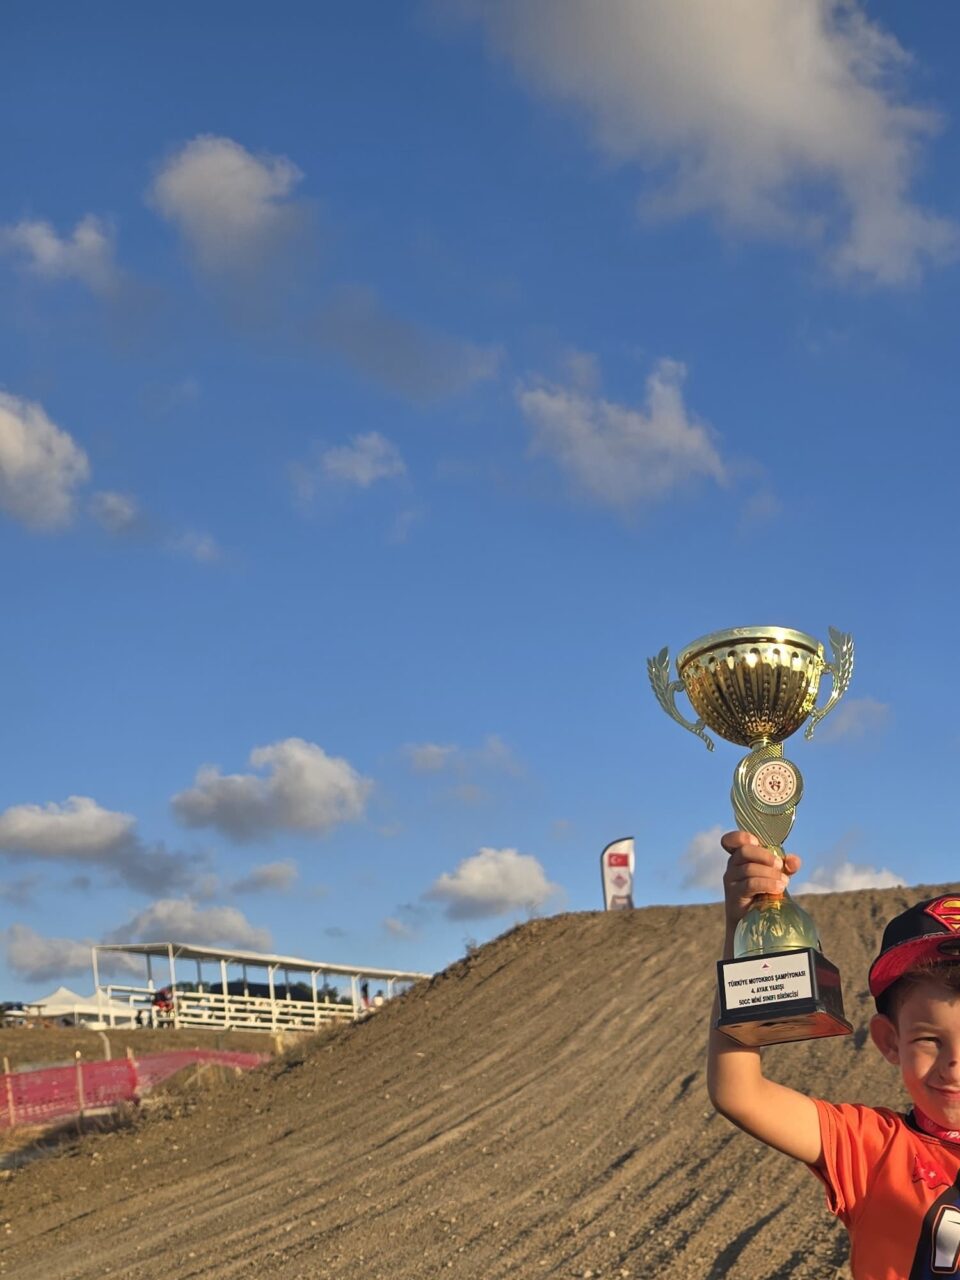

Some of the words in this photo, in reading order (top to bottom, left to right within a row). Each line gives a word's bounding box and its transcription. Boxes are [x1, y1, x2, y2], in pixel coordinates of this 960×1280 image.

[728, 979, 748, 987] TÜRKİYE
[749, 975, 774, 984] MOTOKROS
[775, 971, 806, 981] ŞAMPİYONASI
